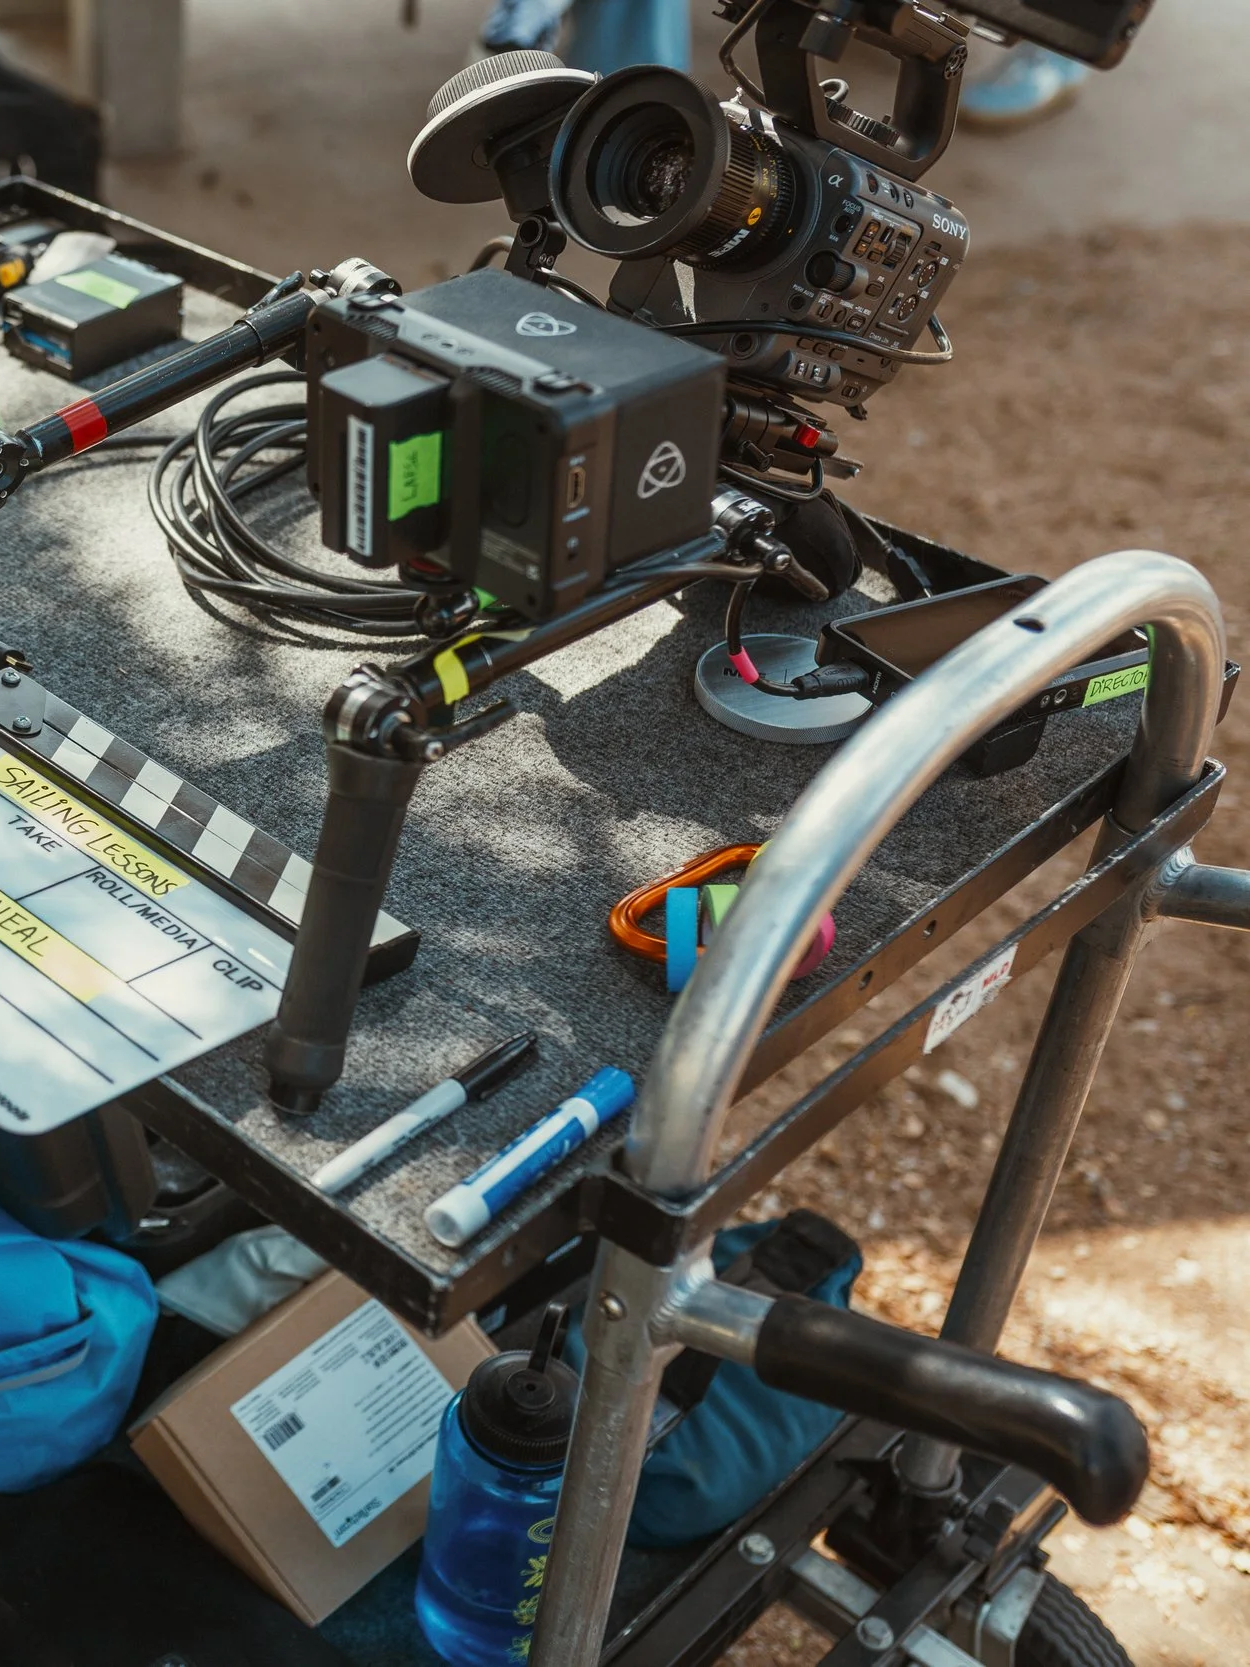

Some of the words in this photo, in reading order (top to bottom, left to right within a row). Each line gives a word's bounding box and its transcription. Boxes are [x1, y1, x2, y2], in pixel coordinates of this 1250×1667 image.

[932, 213, 967, 241] SONY
[7, 815, 63, 853] TAKE
[86, 833, 178, 896] LESSONS
[85, 868, 200, 950] ROLL/MEDIA
[213, 959, 264, 994] CLIP
